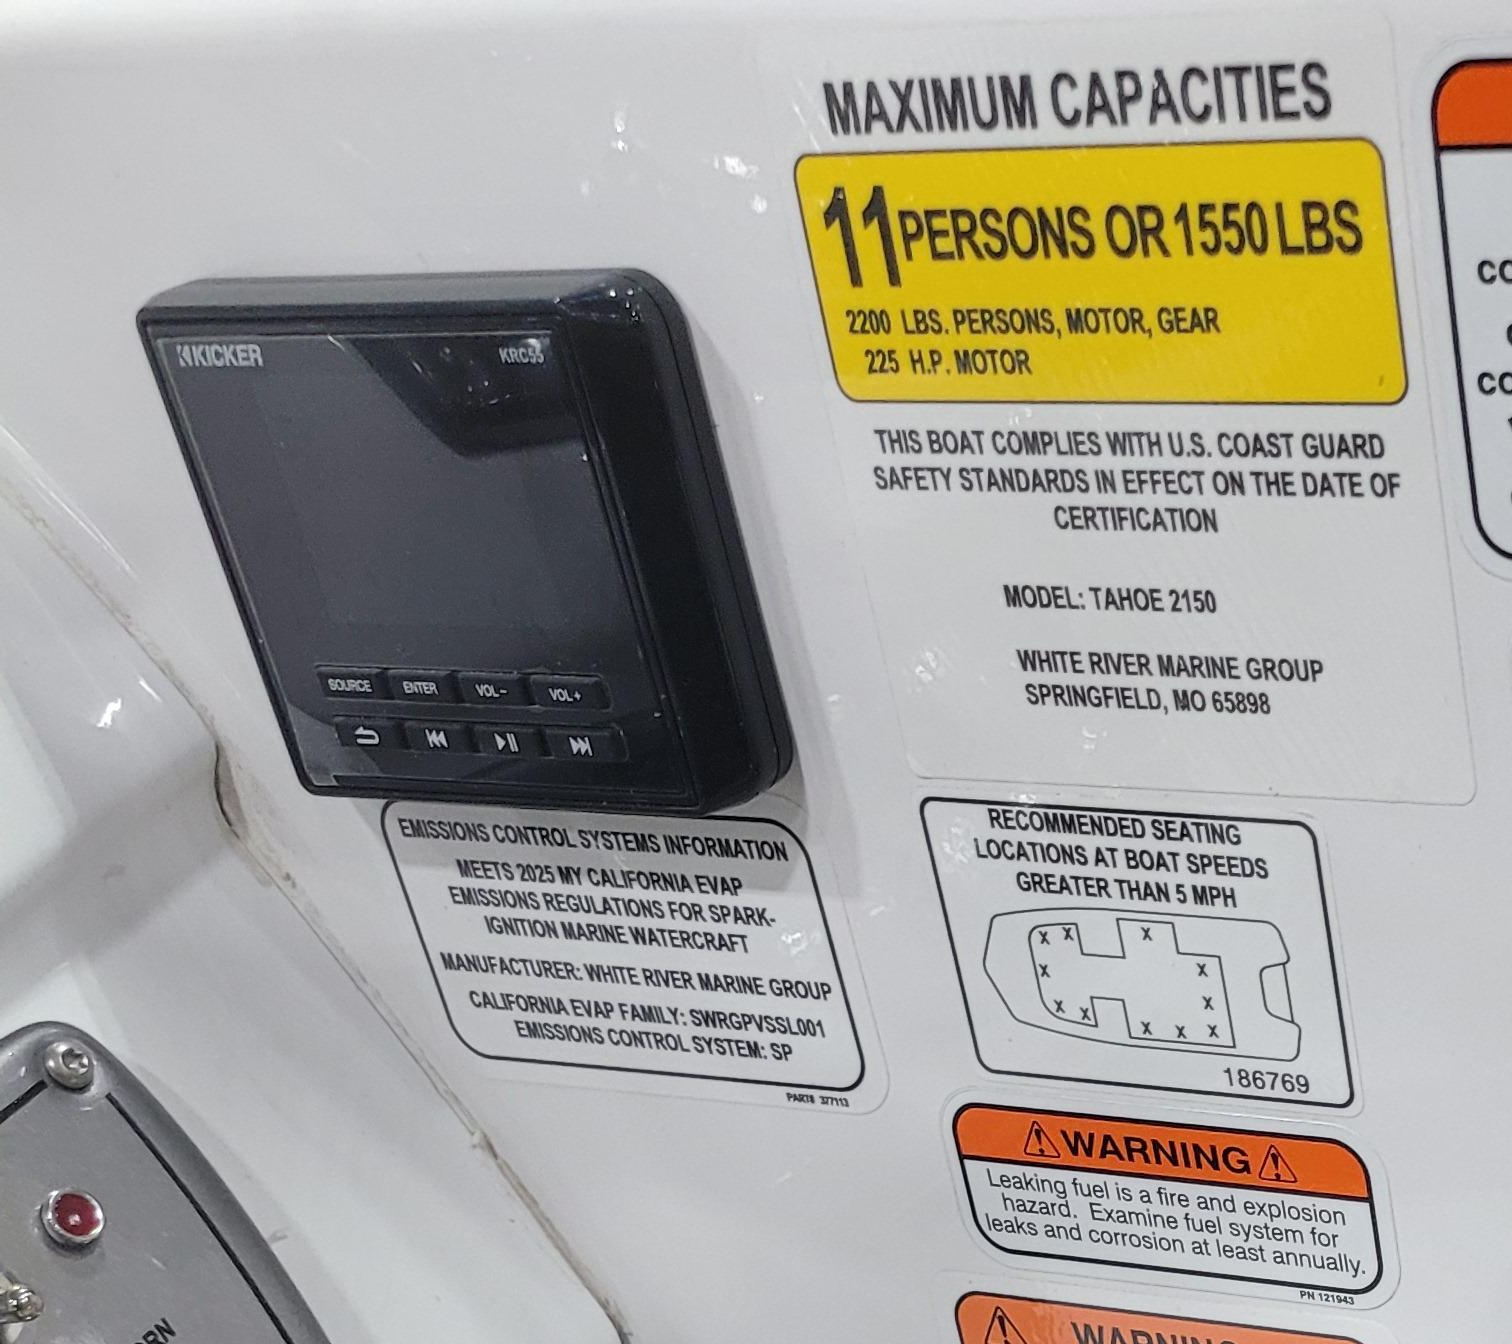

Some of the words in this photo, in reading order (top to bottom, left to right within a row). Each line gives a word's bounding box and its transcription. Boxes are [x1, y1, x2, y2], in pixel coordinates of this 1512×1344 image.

[822, 73, 1038, 136] MAXIMUM
[1050, 61, 1331, 128] CAPACITIES
[823, 185, 902, 289] 11
[897, 205, 1096, 261] PERSONS
[1105, 205, 1170, 259] OR
[1174, 201, 1269, 257] 1550
[1274, 199, 1363, 255] LBS
[845, 308, 891, 334] 2200
[900, 308, 949, 335] LBS.
[951, 307, 1061, 339] PERSONS,
[1064, 307, 1152, 338] MOTOR,
[1156, 306, 1220, 334] GEAR
[191, 343, 264, 367] KICKER
[864, 348, 899, 374] 225
[908, 348, 950, 374] H.P.
[953, 348, 1032, 375] MOTOR
[873, 429, 923, 454] THIS
[925, 429, 984, 455] BOAT
[991, 430, 1102, 456] COMPLIES
[1104, 431, 1163, 457] WITH
[1167, 431, 1212, 457] U.S.
[1217, 431, 1293, 458] COAST
[1301, 432, 1385, 459] GUARD
[873, 465, 951, 491] SAFETY
[958, 466, 1090, 493] STANDARDS
[1094, 469, 1116, 493] IN
[1121, 469, 1205, 495] EFFECT
[1211, 470, 1245, 495] ON
[1249, 470, 1296, 496] THE
[1300, 471, 1364, 497] DATE
[1369, 472, 1400, 498] OF
[1053, 505, 1218, 533] CERTIFICATION
[1002, 584, 1085, 609] MODEL:
[1088, 586, 1164, 611] TAHOE
[1168, 588, 1216, 613] 2150
[1015, 649, 1085, 673] WHITE
[1087, 651, 1153, 676] RIVER
[1156, 654, 1241, 679] MARINE
[1245, 657, 1323, 682] GROUP
[327, 678, 373, 693] SOURCE
[402, 680, 439, 695] ENTER
[1024, 682, 1168, 713] SPRINGFIELD,
[1172, 688, 1206, 712] MO
[1211, 690, 1270, 714] 65898
[397, 817, 490, 842] EMISSIONS
[491, 823, 578, 848] CONTROL
[577, 828, 661, 853] SYSTEMS
[662, 833, 788, 861] INFORMATION
[987, 807, 1145, 838] RECOMMENDED
[1150, 818, 1241, 845] SEATING
[973, 837, 1088, 866] LOCATIONS
[1094, 846, 1118, 868] AT
[1123, 848, 1180, 872] BOAT
[1185, 852, 1268, 879] SPEEDS
[455, 858, 514, 880] MEETS
[515, 863, 555, 883] 2025
[556, 865, 582, 885] MY
[587, 868, 693, 894] CALIFORNIA
[696, 875, 743, 897] EVAP
[1015, 871, 1112, 898] GREATER
[1113, 878, 1170, 902] THAN
[1175, 883, 1187, 904] 5
[1191, 884, 1237, 908] MPH
[439, 951, 583, 980] MANUFACTURER:
[582, 963, 641, 985] WHITE
[641, 967, 696, 990] RIVER
[696, 972, 766, 995] MARINE
[768, 977, 831, 1000] GROUP
[1223, 1067, 1309, 1094] 186769
[1059, 1129, 1251, 1174] WARNING
[986, 1167, 1067, 1199] Leaking
[1070, 1177, 1109, 1199] fuel
[1114, 1181, 1133, 1202] is
[1138, 1189, 1152, 1204] a
[1155, 1186, 1190, 1208] fire
[1196, 1194, 1236, 1213] and
[1243, 1199, 1346, 1225] explosion
[1299, 1289, 1315, 1300] PN
